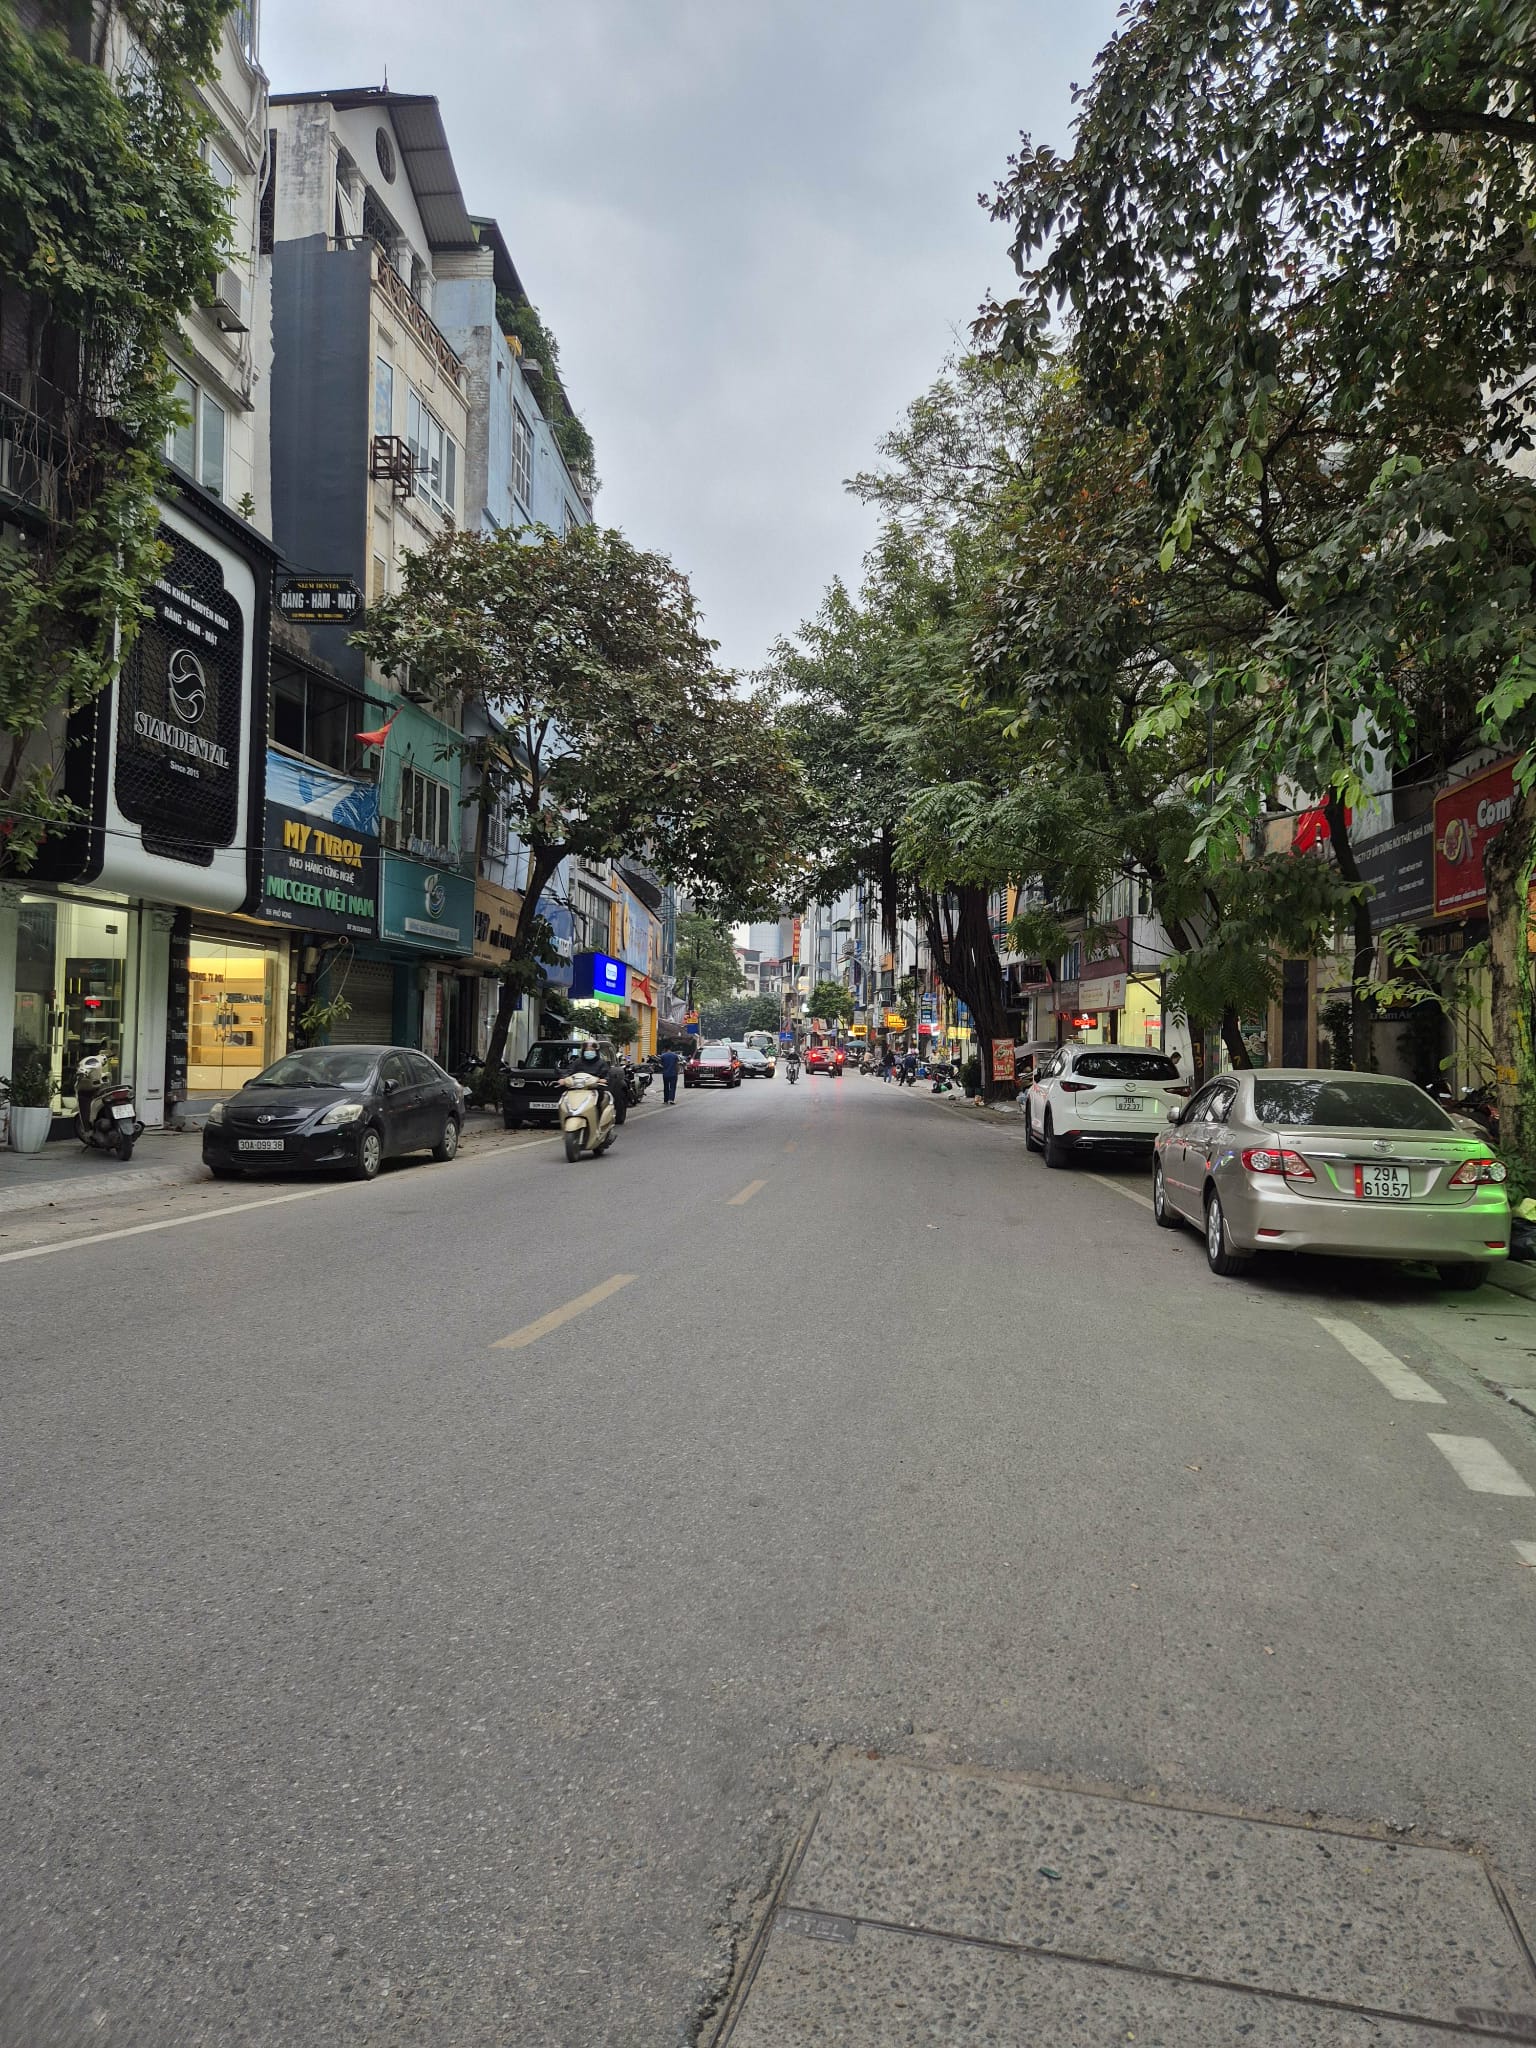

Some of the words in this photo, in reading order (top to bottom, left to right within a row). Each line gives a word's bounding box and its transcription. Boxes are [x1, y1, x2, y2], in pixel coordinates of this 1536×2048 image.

[155, 577, 171, 595] ÒNG
[172, 586, 190, 606] KHÁM
[191, 598, 213, 620] CHUYÊN
[214, 612, 229, 630] KHOA
[311, 590, 331, 609] HÀM
[337, 590, 356, 613] MẶT
[205, 630, 218, 647] MẶT
[170, 760, 186, 774] Since
[186, 766, 200, 779] 2015
[283, 820, 311, 853] MY
[313, 829, 363, 868] TVBOX
[289, 856, 303, 870] KHO
[304, 860, 323, 875] HÀNG
[323, 865, 340, 879] CÔNG
[340, 871, 355, 886] NGHỆ
[265, 875, 322, 907] MICGEEK
[323, 886, 347, 915] VIỆT
[348, 894, 375, 918] NAM
[1374, 1167, 1399, 1182] 29A
[1364, 1182, 1409, 1197] 619.57
